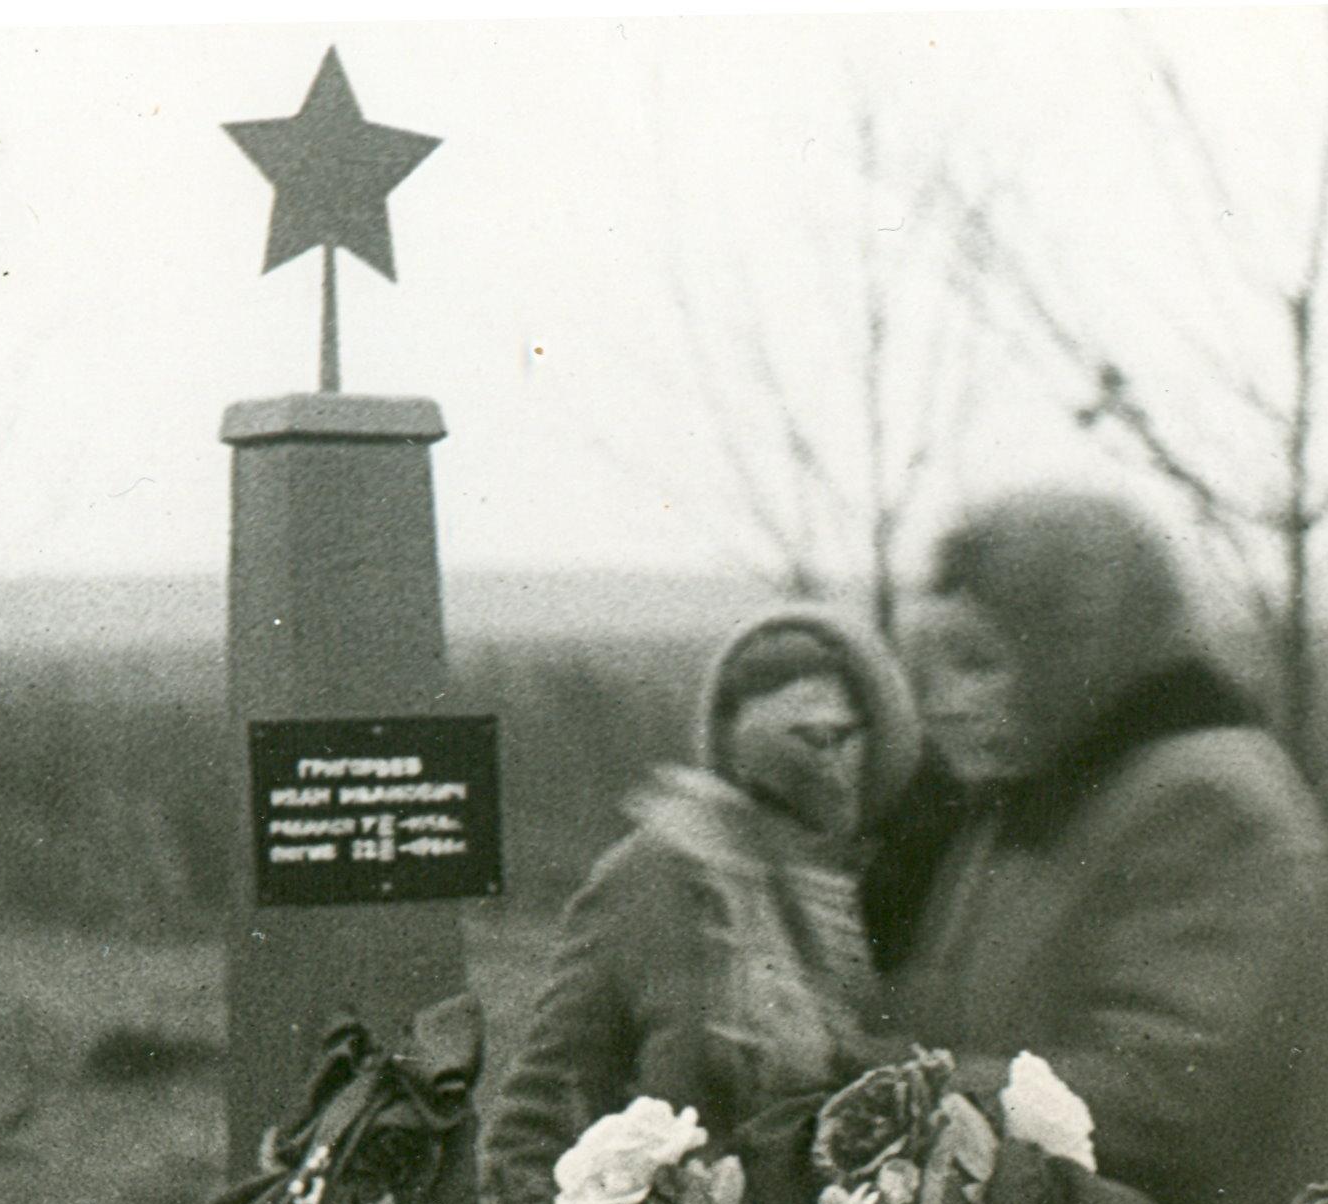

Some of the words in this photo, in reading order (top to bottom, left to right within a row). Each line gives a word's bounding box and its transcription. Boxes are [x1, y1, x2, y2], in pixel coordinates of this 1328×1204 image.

[297, 756, 423, 779] ГРИГОРЬЕВ
[270, 787, 333, 807] ИВАН
[338, 782, 468, 805] ИВАНОВИЧ
